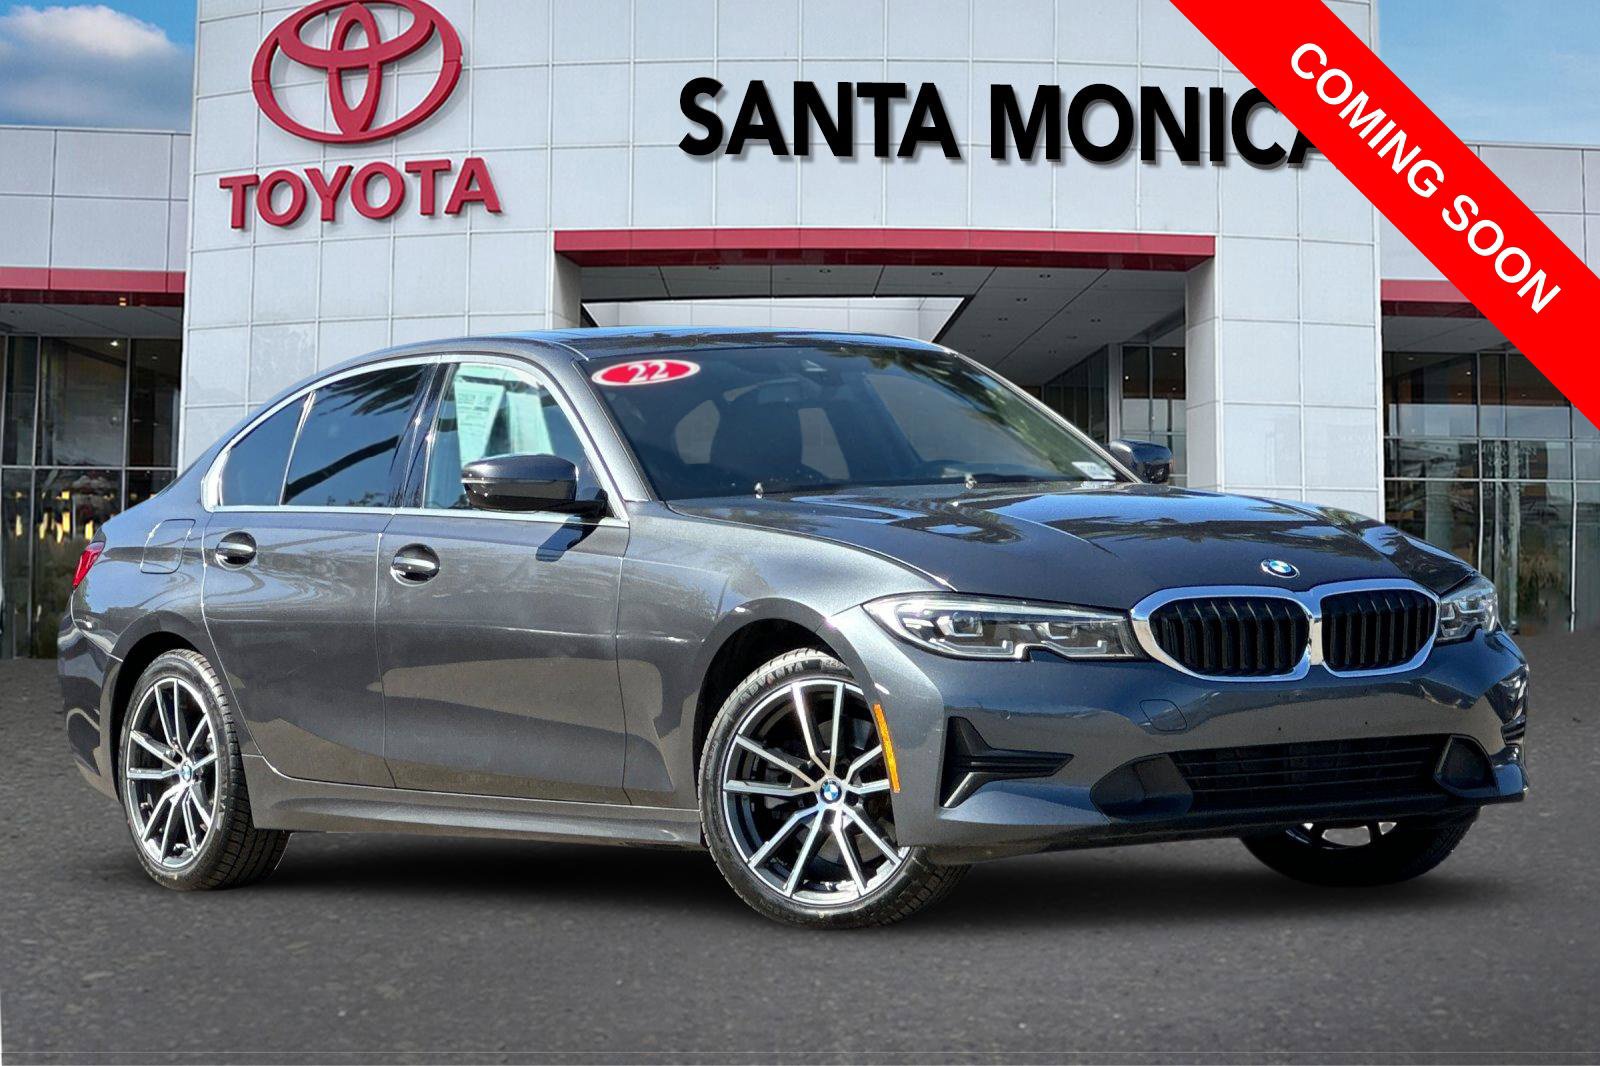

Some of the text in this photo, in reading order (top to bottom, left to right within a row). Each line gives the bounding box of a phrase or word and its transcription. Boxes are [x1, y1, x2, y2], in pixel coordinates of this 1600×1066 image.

[679, 77, 1321, 167] SANTA MONIC
[219, 157, 502, 229] TOYOTA
[627, 361, 669, 383] 22
